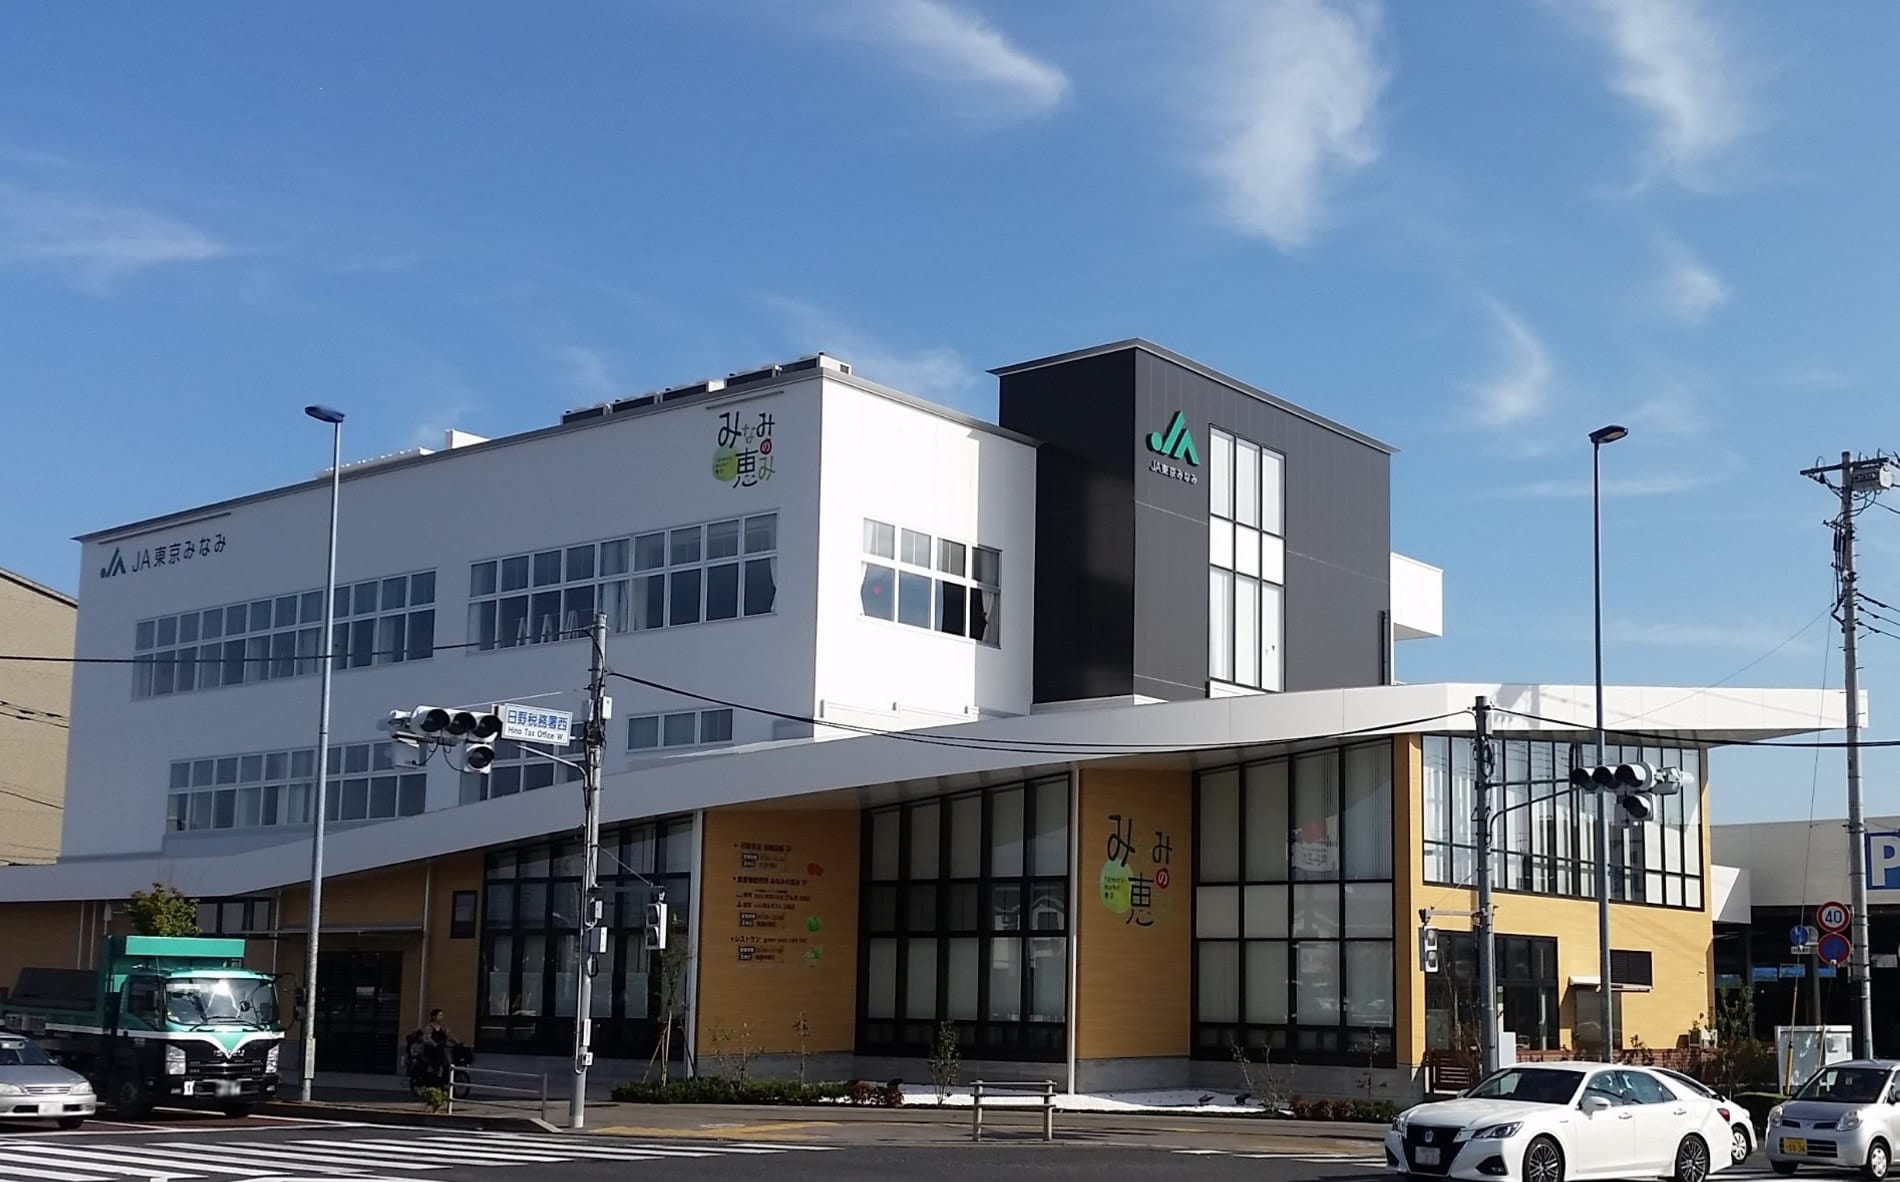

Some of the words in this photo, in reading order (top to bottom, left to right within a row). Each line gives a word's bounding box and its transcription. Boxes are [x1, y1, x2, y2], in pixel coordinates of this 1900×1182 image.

[132, 533, 227, 573] JA東京みなみ
[507, 709, 569, 731] 日野税務署西
[1870, 836, 1900, 887] P
[1825, 910, 1843, 924] 40
